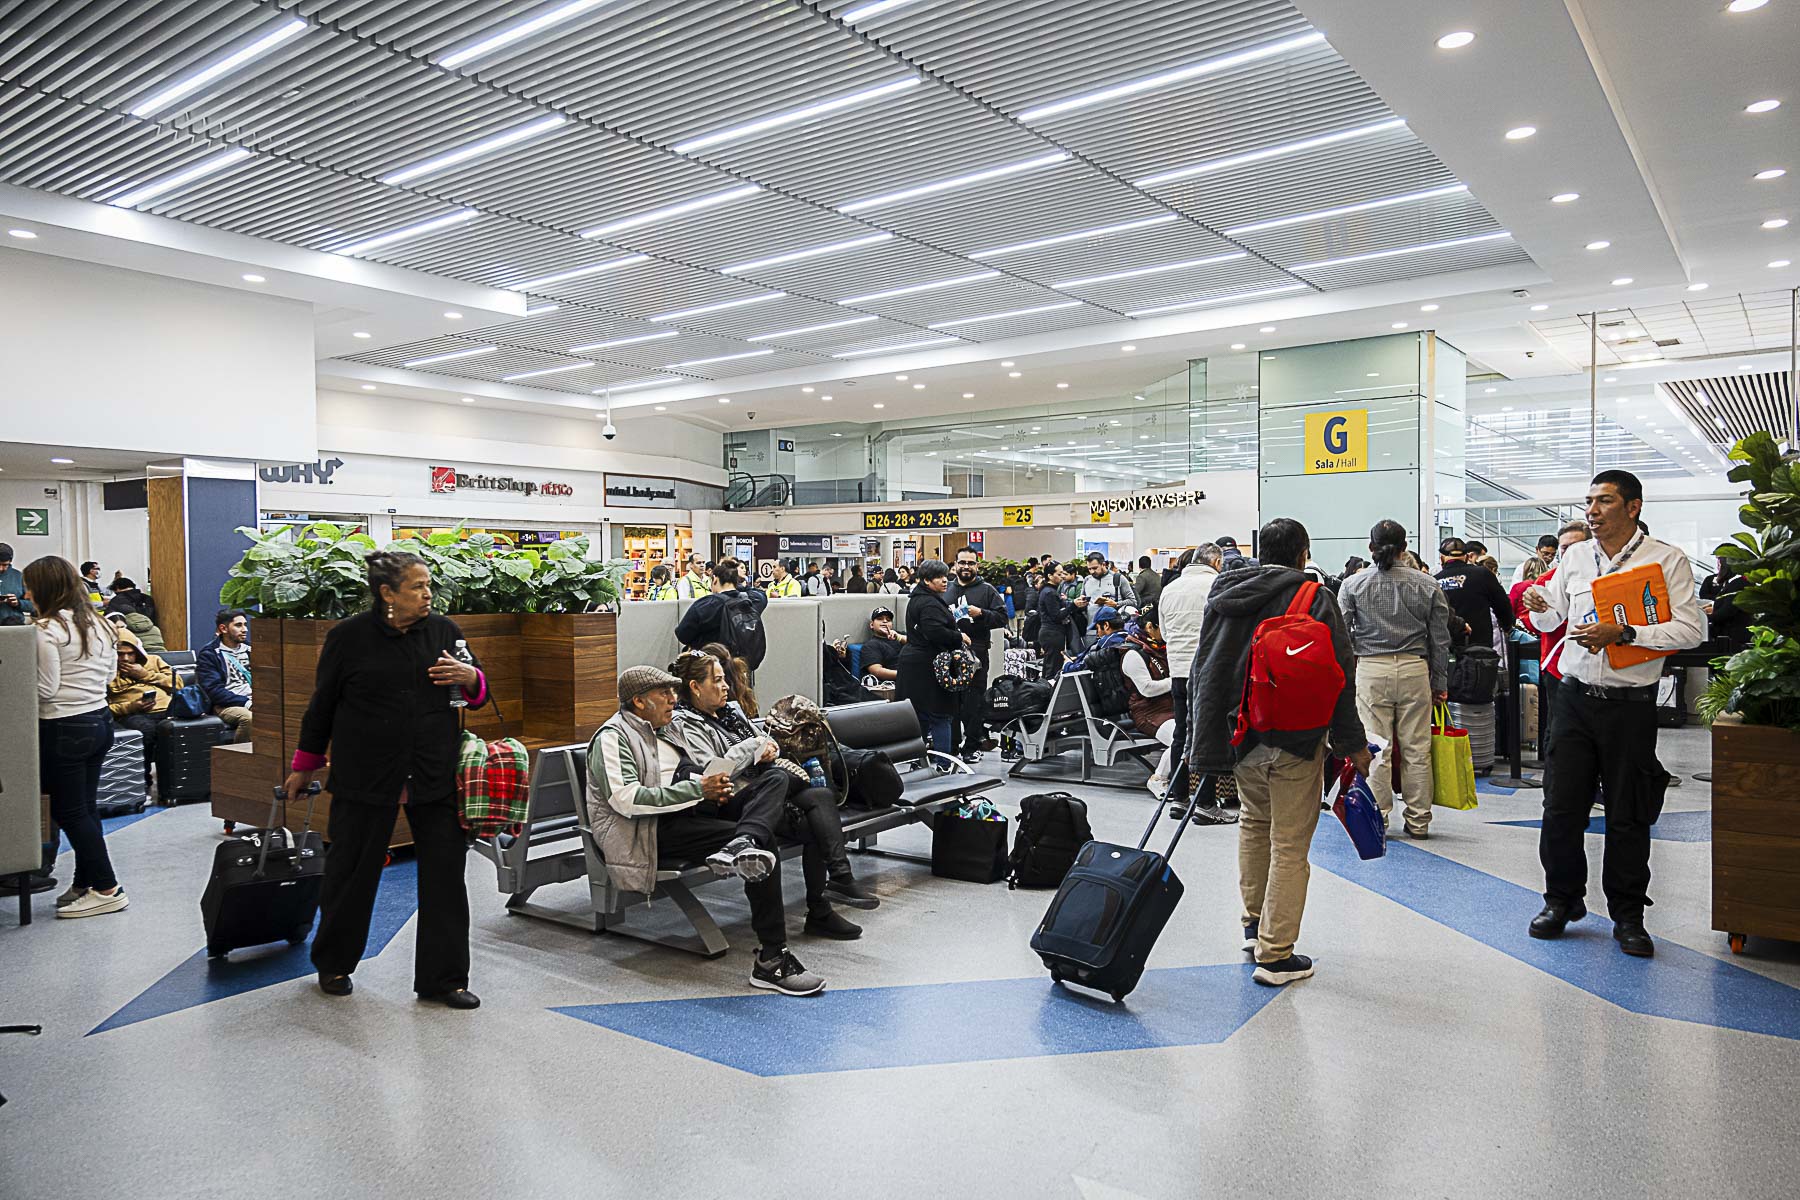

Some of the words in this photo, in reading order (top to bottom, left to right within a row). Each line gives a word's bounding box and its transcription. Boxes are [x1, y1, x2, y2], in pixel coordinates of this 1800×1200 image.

[1324, 416, 1348, 455] G
[1315, 458, 1334, 469] Sala
[1341, 457, 1357, 467] Hall
[1089, 496, 1137, 514] MAISON
[877, 513, 908, 527] 26-28
[919, 512, 952, 527] 29-36
[1016, 508, 1032, 523] 25
